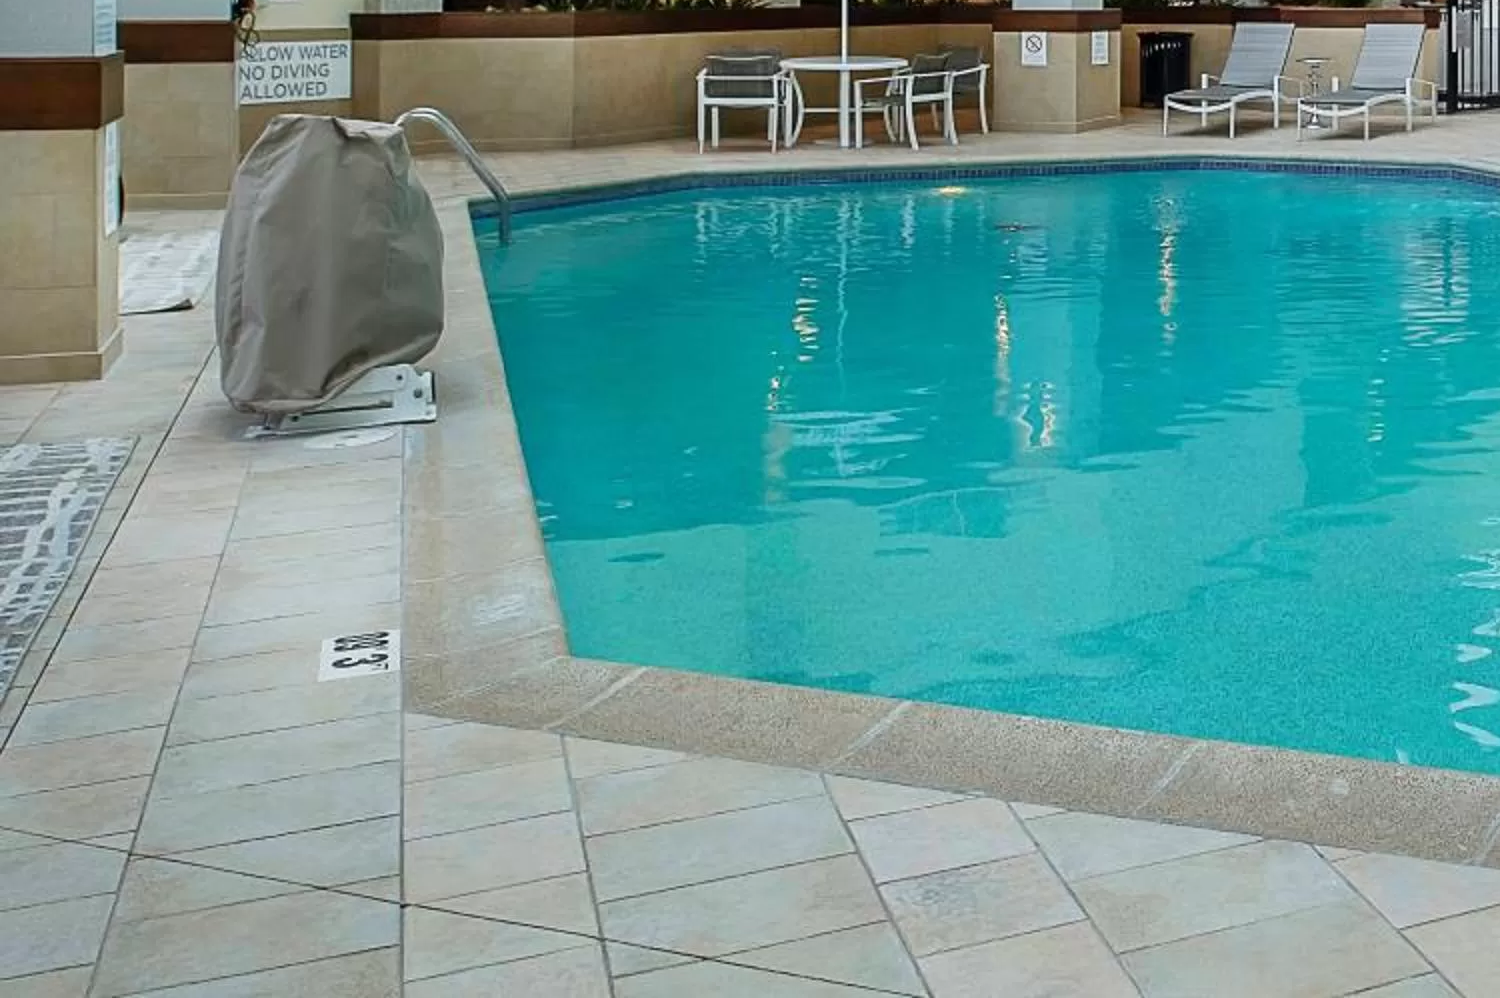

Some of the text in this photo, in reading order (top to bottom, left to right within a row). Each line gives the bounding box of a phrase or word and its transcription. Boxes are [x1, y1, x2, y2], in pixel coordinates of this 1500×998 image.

[298, 43, 349, 60] WATER
[240, 63, 331, 81] NO DIVING
[241, 81, 328, 100] ALLOWED
